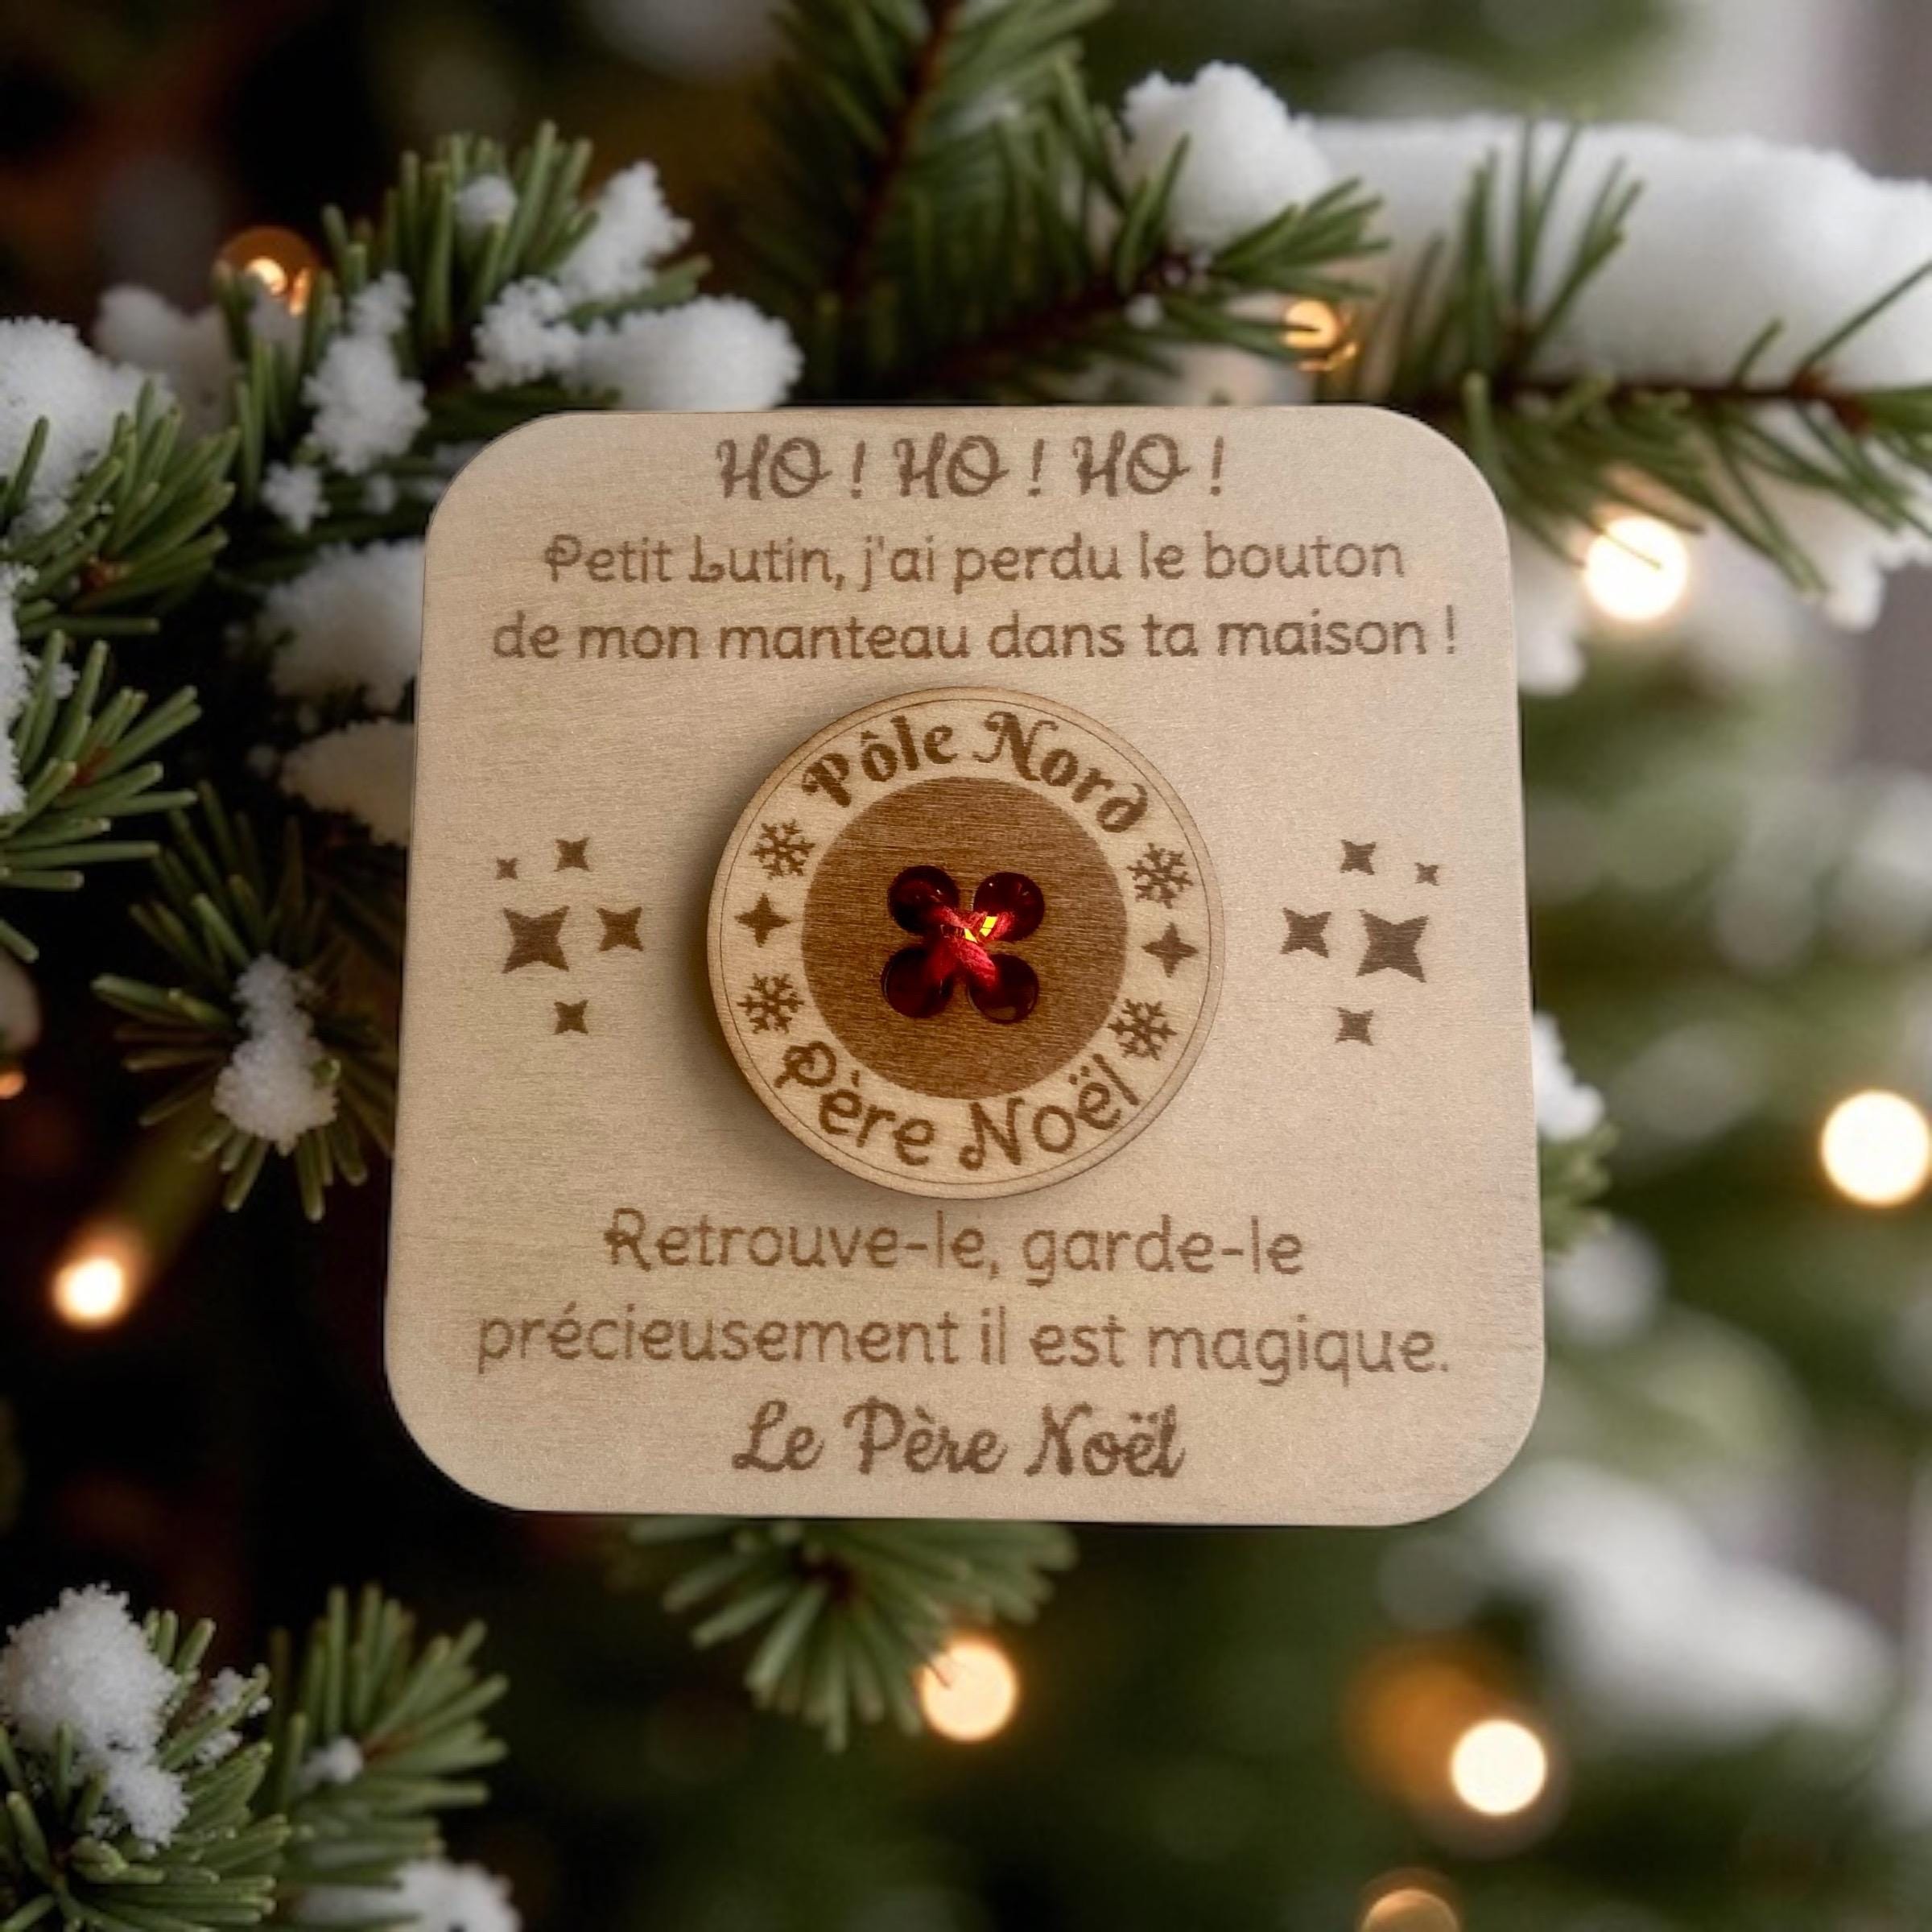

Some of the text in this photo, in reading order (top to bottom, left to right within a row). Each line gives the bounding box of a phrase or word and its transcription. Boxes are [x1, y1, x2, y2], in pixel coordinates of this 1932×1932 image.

[716, 431, 1224, 499] HO ! HO ! HO !
[544, 530, 1405, 594] Petit Lutin, j'ai perdu le bouton
[493, 605, 1455, 659] de mon manteau dans ta maison !
[802, 712, 1149, 833] Pôle Nord
[774, 1041, 1140, 1170] Père Noël
[604, 1208, 1304, 1287] Retrouve-le, garde-le
[478, 1301, 1449, 1387] précieusement il est magique.
[732, 1395, 1187, 1478] Le Père Noël
